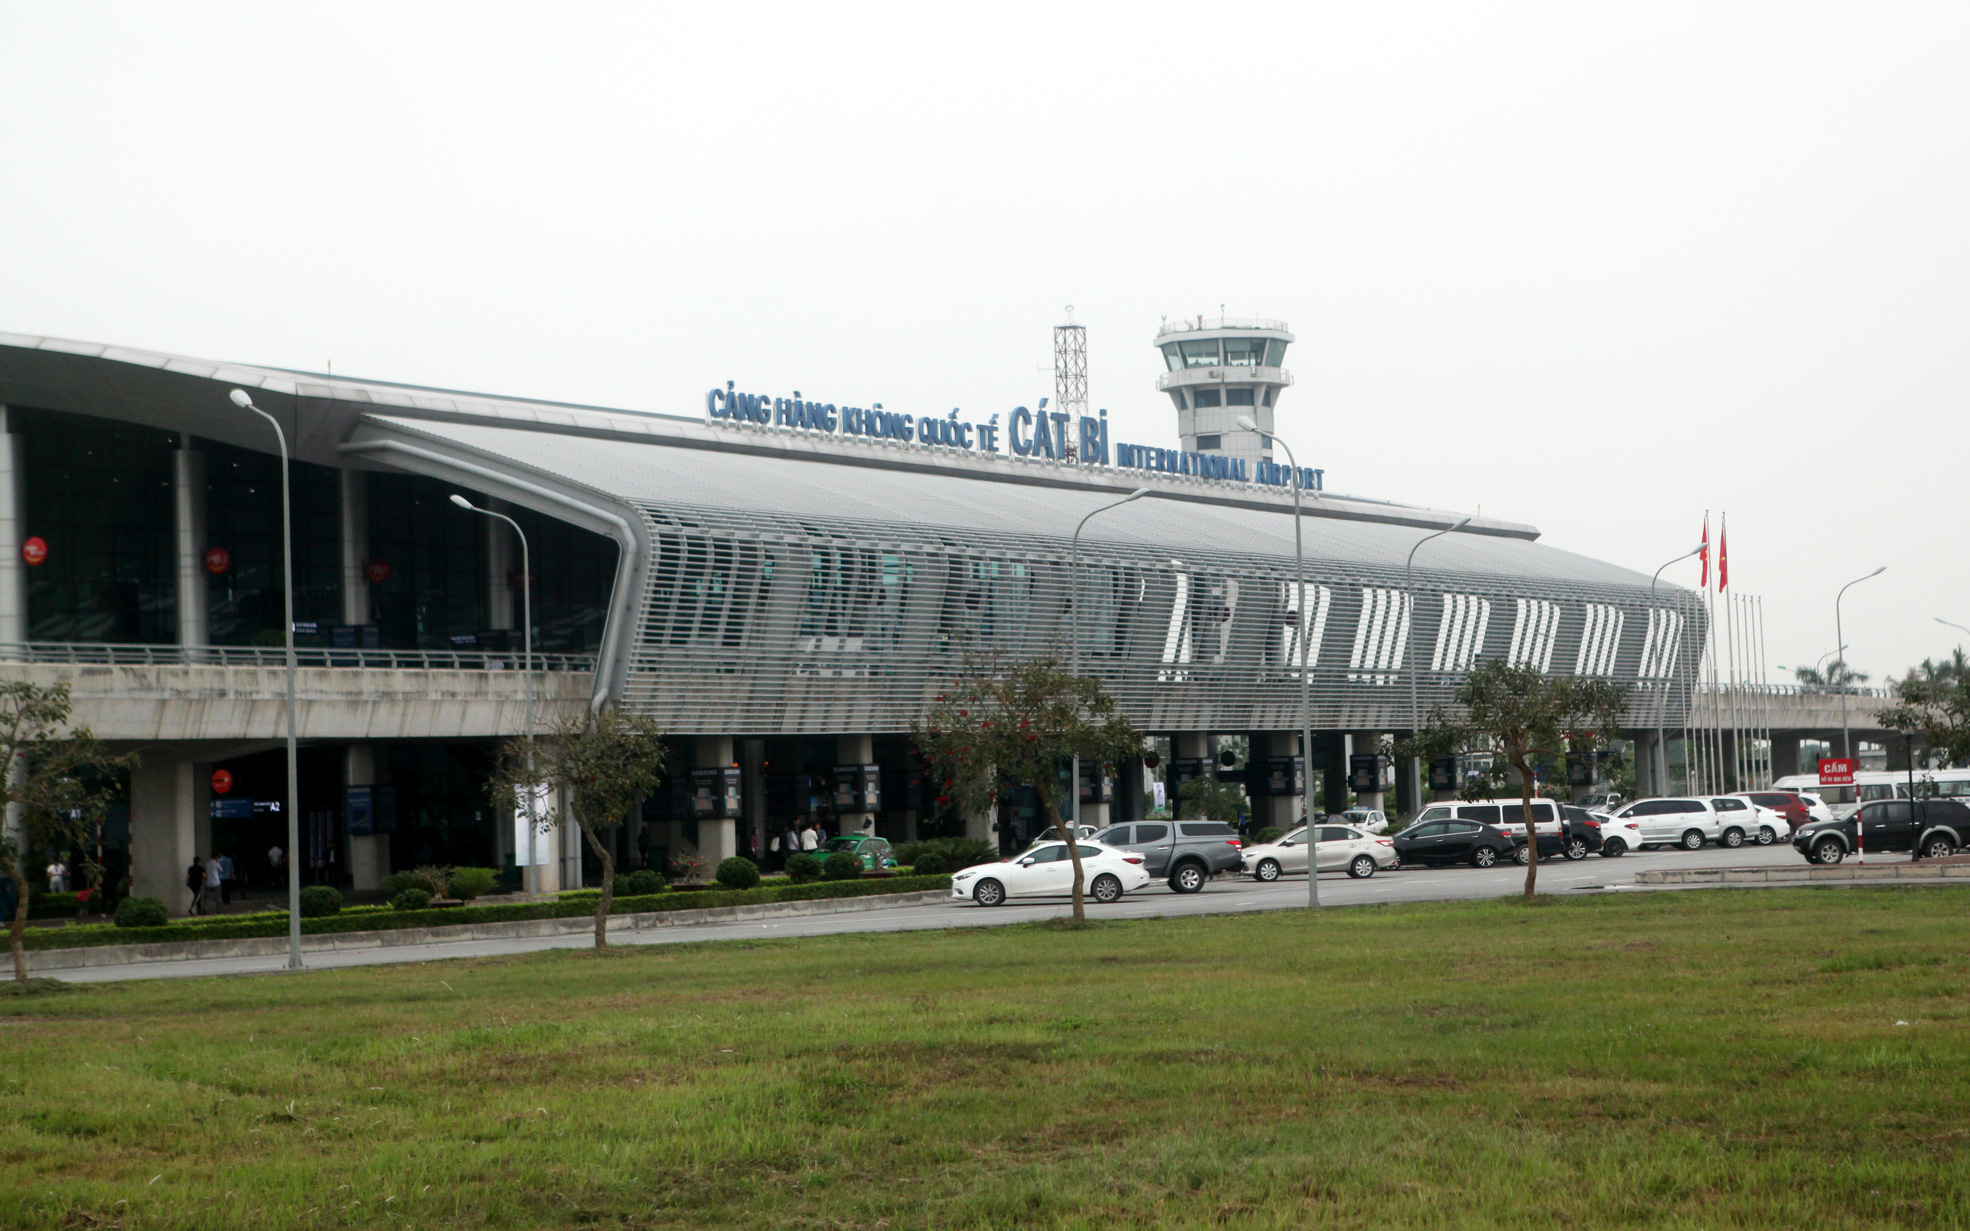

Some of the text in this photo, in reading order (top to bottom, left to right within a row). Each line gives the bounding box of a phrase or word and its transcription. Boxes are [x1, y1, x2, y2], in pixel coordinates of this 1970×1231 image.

[708, 380, 771, 424] CẢNG
[775, 391, 837, 431] HÀNG
[842, 403, 914, 441] KHÔNG
[918, 408, 973, 449] QUỐC
[976, 414, 999, 452] TẾ
[1010, 397, 1070, 461] CÁT
[1117, 442, 1250, 481] INTERNATIONAL
[1824, 761, 1847, 773] CẤM
[270, 801, 280, 812] A2
